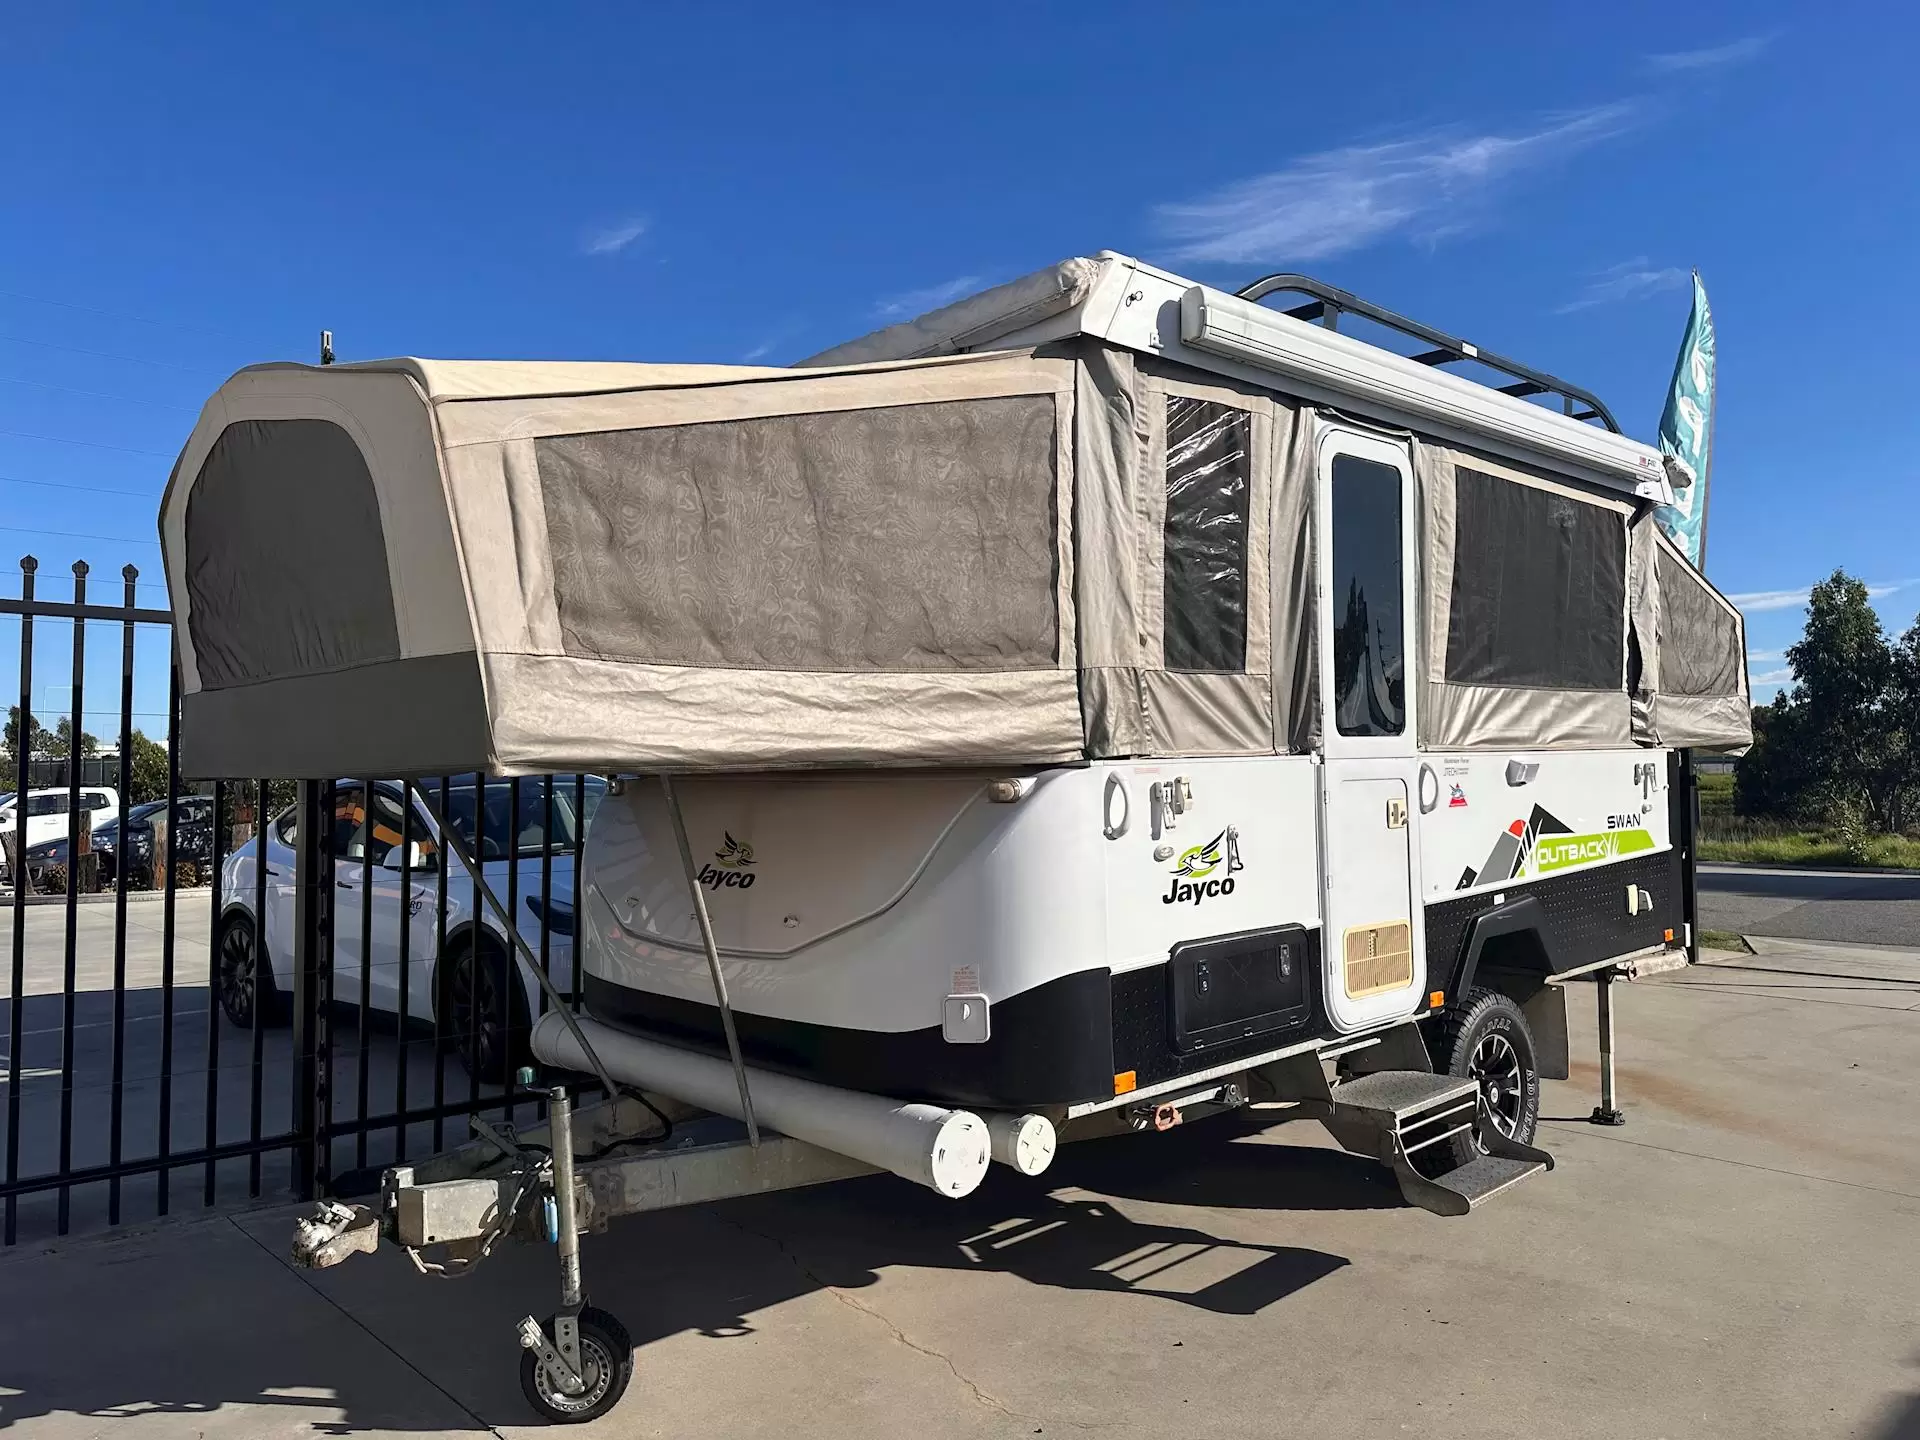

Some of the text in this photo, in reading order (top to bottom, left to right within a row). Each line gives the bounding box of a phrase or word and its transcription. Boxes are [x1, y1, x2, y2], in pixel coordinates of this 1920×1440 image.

[1607, 813, 1641, 829] SWAN
[1539, 840, 1606, 865] OUTBACK
[1162, 877, 1235, 906] Jayco
